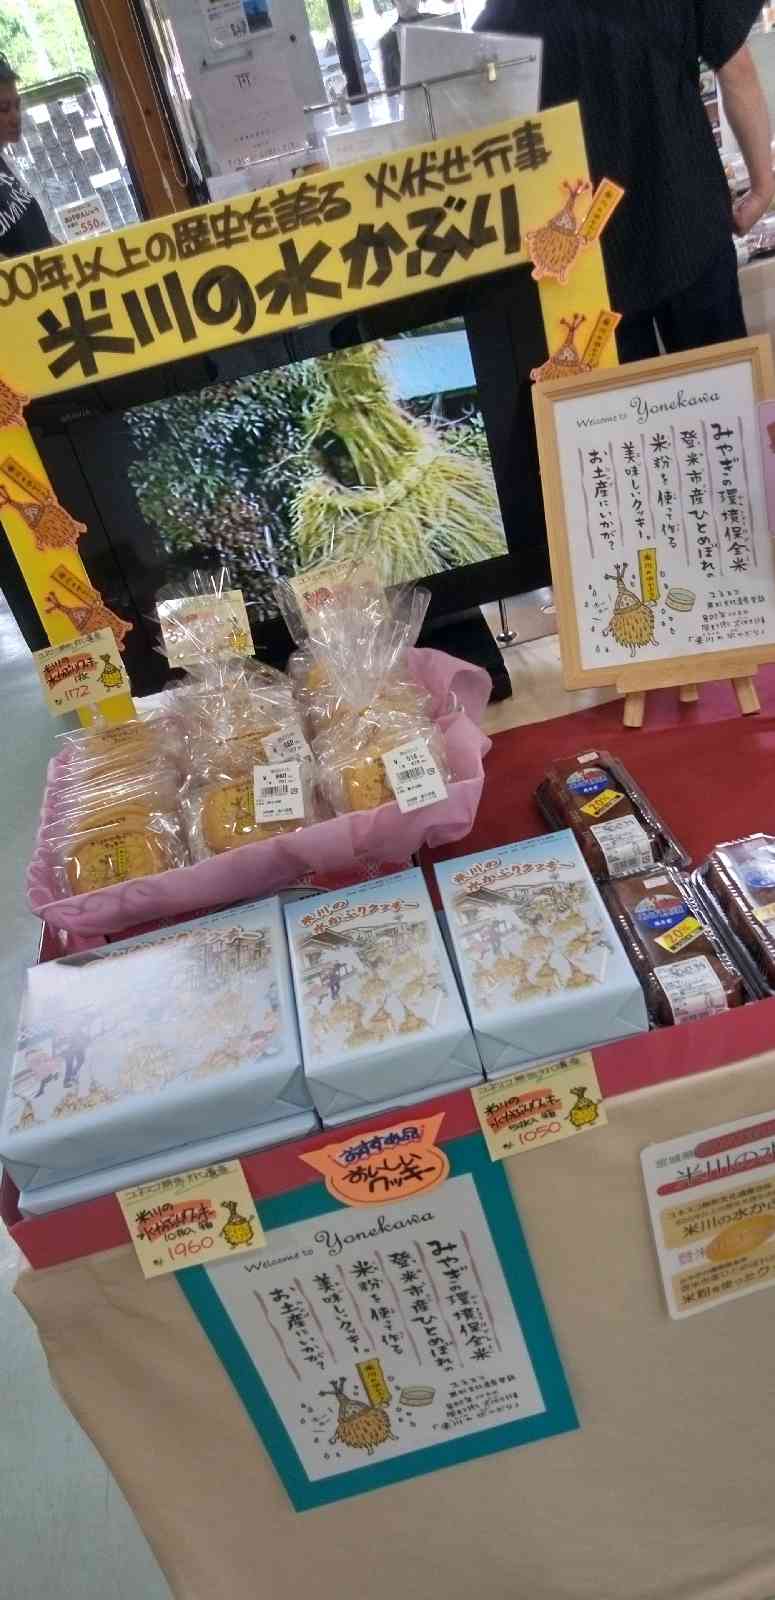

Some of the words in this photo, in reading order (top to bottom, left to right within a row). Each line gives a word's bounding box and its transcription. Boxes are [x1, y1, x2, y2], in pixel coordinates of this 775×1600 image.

[365, 120, 552, 208] 火伏せ行事
[37, 184, 521, 379] 米川の水かぶり
[629, 389, 720, 425] Yonekawa
[650, 433, 678, 548] 米粉を使って作る
[710, 423, 750, 573] みやぎの環境保全米
[342, 1152, 424, 1184] おいしい
[368, 1165, 436, 1193] クッキー
[168, 1235, 215, 1261] 1960
[243, 1252, 301, 1274] Welcome
[314, 1211, 436, 1257] Yonekawa
[351, 1260, 404, 1355] 米粉を使って作る
[427, 1239, 492, 1361] みやぎの環境保全米
